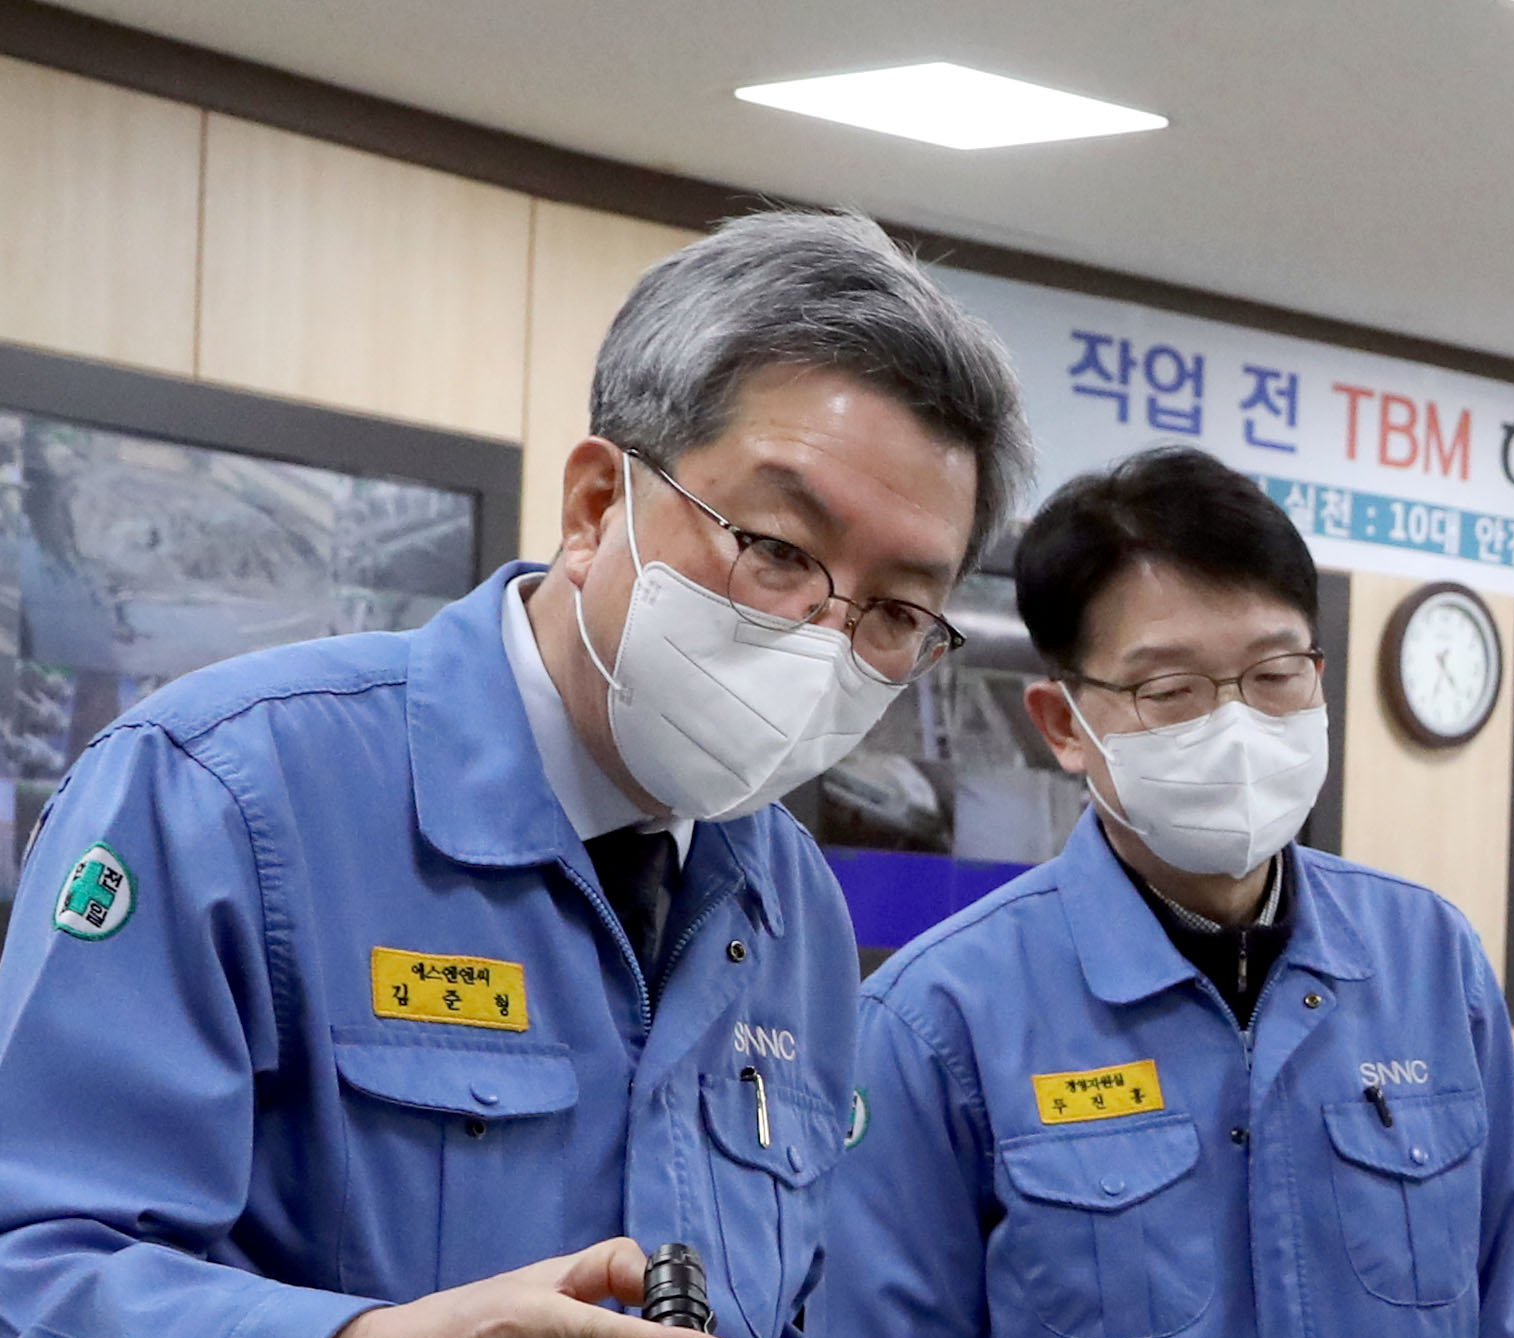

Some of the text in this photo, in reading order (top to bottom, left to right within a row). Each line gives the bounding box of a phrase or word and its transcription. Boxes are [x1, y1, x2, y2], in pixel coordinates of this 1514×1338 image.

[1067, 329, 1205, 436] 작업
[1240, 362, 1298, 453] 전
[1331, 382, 1473, 483] TBM
[1389, 502, 1460, 555] 10대
[734, 1021, 796, 1062] SNNC
[1360, 1059, 1428, 1086] SNNC
